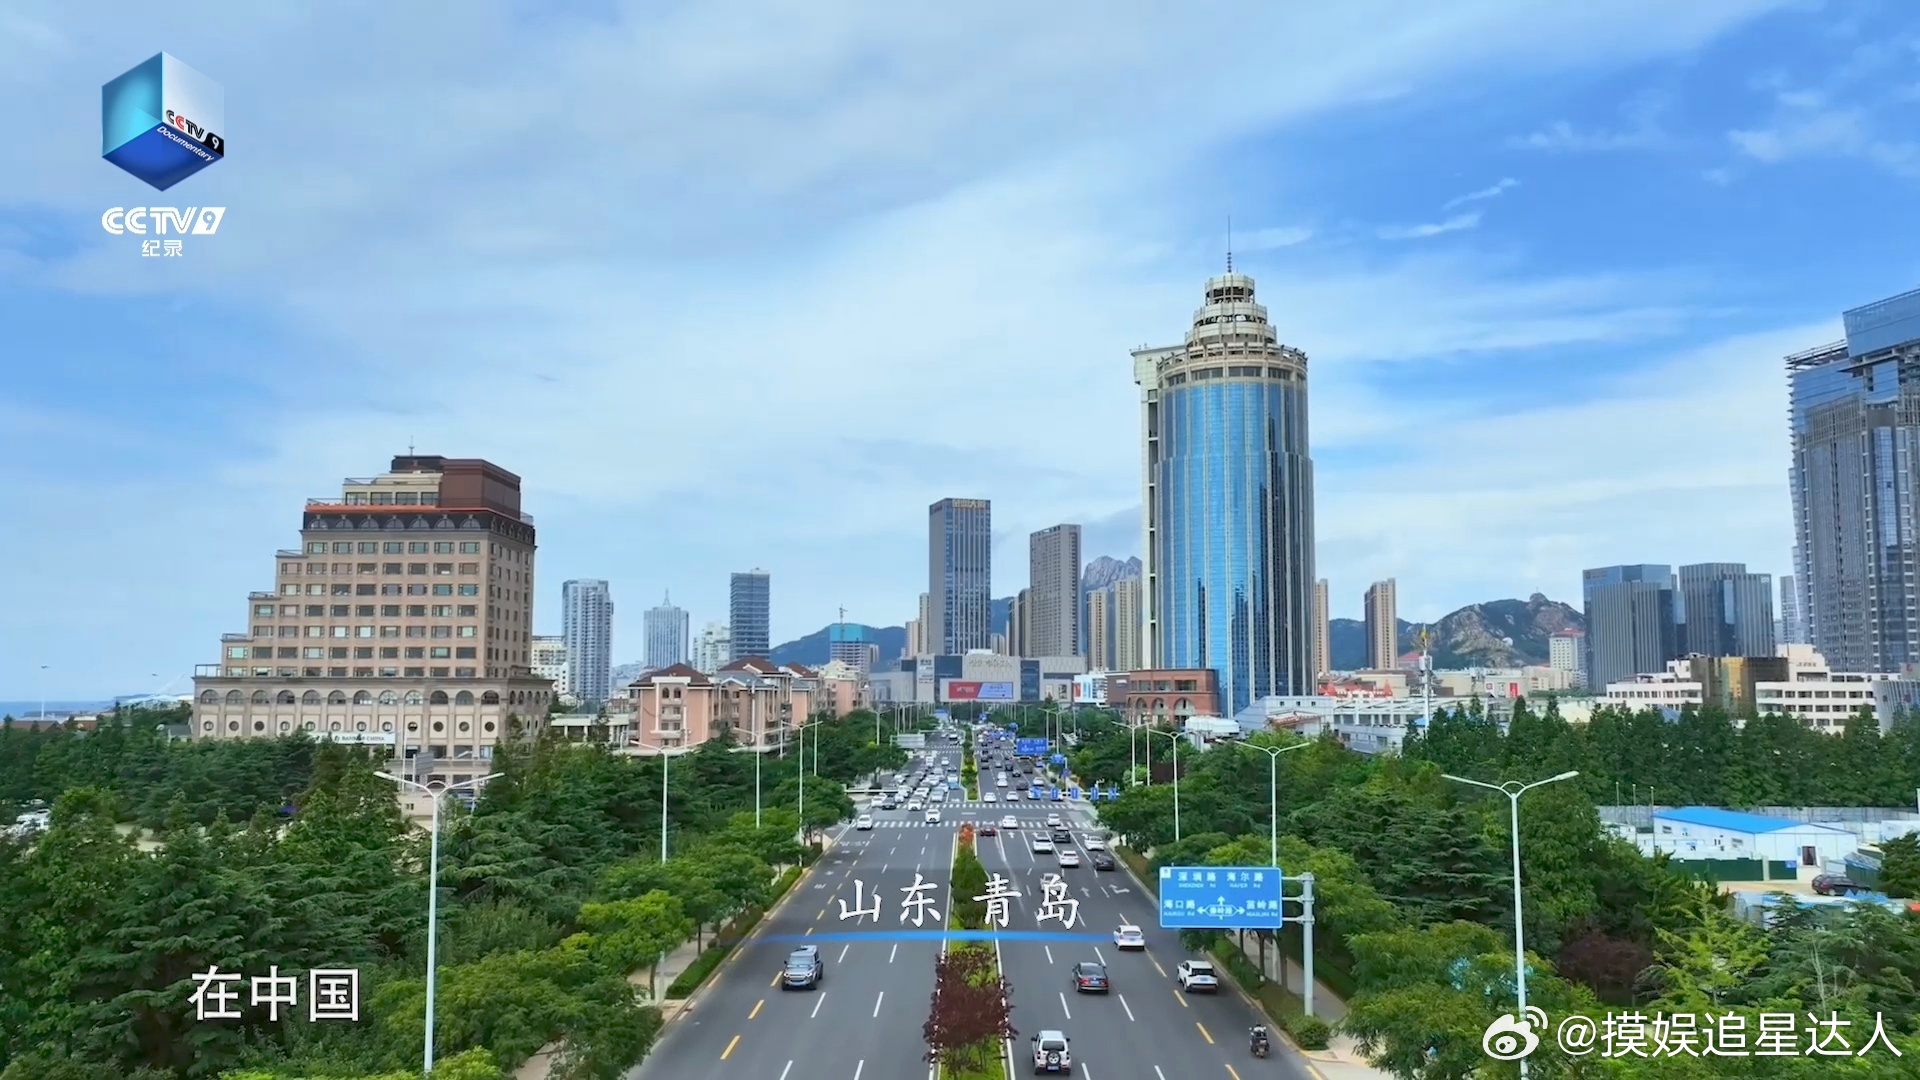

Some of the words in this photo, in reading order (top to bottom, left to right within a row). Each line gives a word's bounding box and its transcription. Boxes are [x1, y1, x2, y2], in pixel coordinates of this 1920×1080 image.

[1177, 871, 1216, 882] 深圳路
[1226, 871, 1263, 882] 海尔路
[1163, 899, 1195, 909] 海口路
